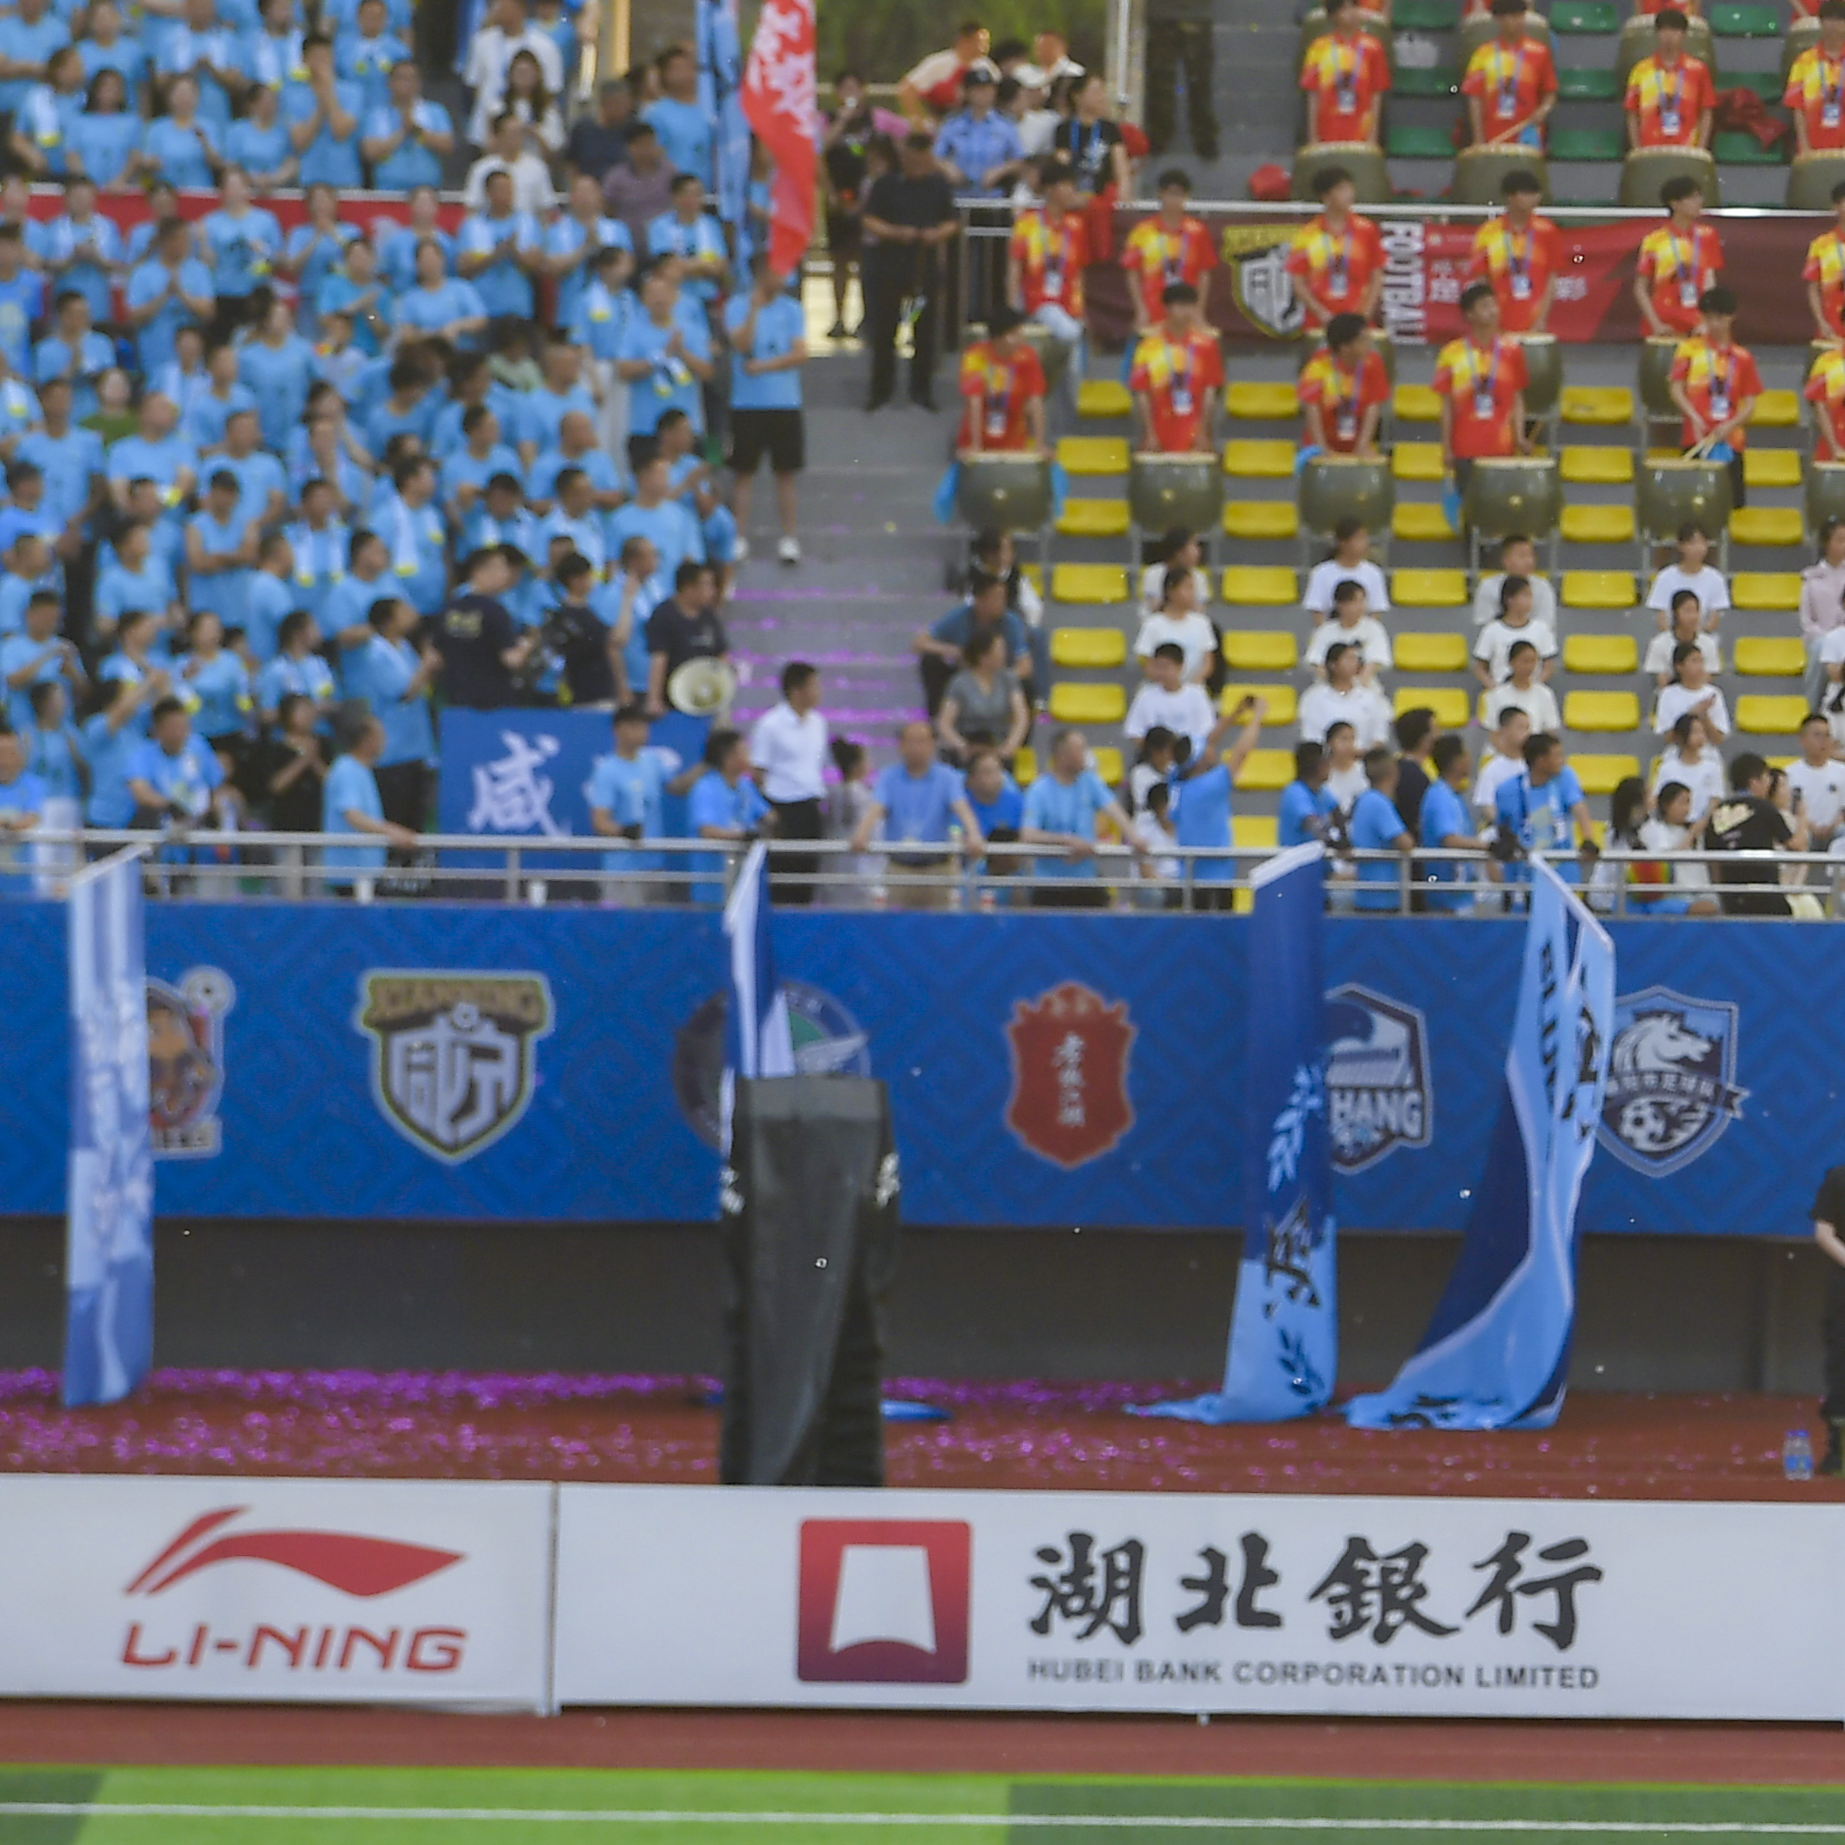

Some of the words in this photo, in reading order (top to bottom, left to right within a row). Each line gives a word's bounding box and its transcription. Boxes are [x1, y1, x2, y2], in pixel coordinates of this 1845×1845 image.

[1028, 1531, 1602, 1650] 湖北銀行
[120, 1622, 468, 1672] LI-NING
[1028, 1658, 1125, 1684] HUBEI
[1137, 1659, 1222, 1686] BANK
[1233, 1661, 1464, 1689] CORPORATION
[1475, 1665, 1601, 1690] LIMITED
